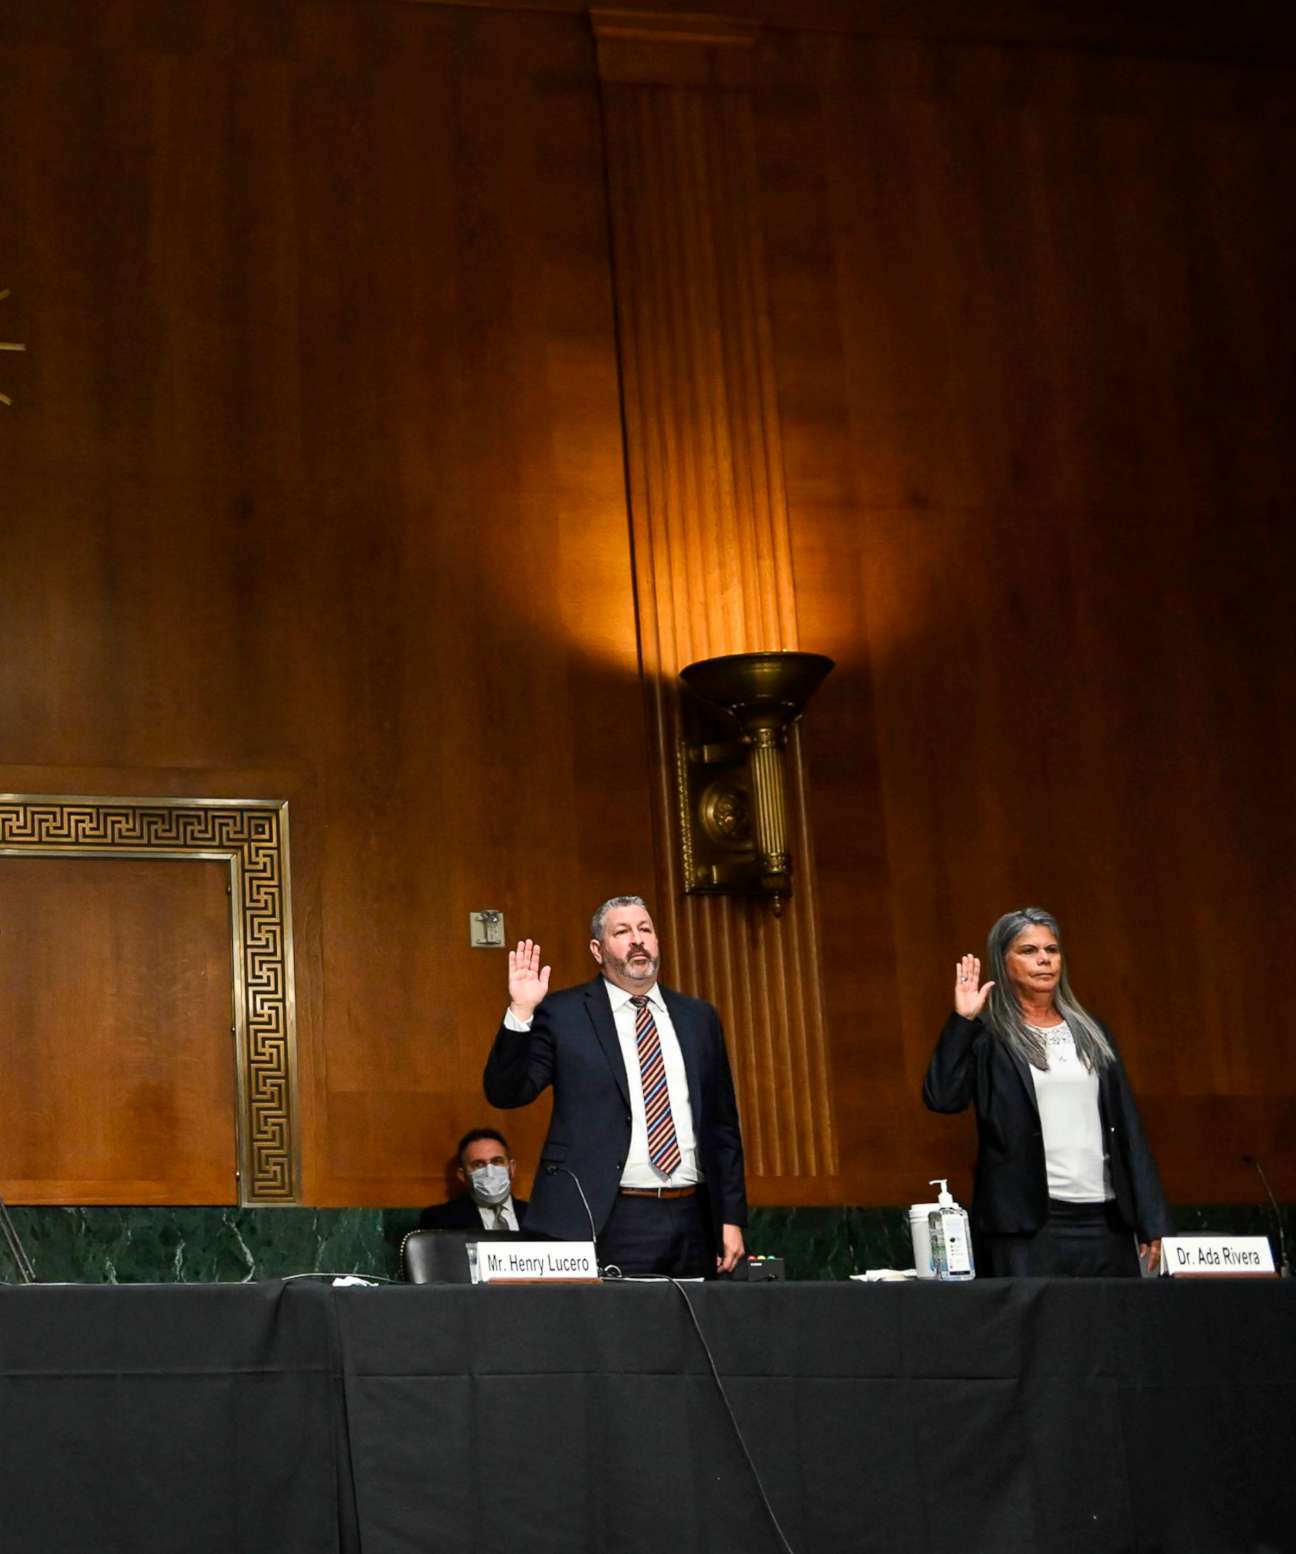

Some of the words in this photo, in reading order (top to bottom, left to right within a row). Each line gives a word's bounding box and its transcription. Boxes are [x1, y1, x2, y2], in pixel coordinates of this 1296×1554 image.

[487, 1254, 506, 1271] Mr.
[508, 1254, 544, 1275] Henry
[547, 1254, 589, 1271] Lucero
[1176, 1247, 1195, 1265] Dr.
[1198, 1247, 1220, 1265] Ada
[1222, 1247, 1260, 1265] Rivera
